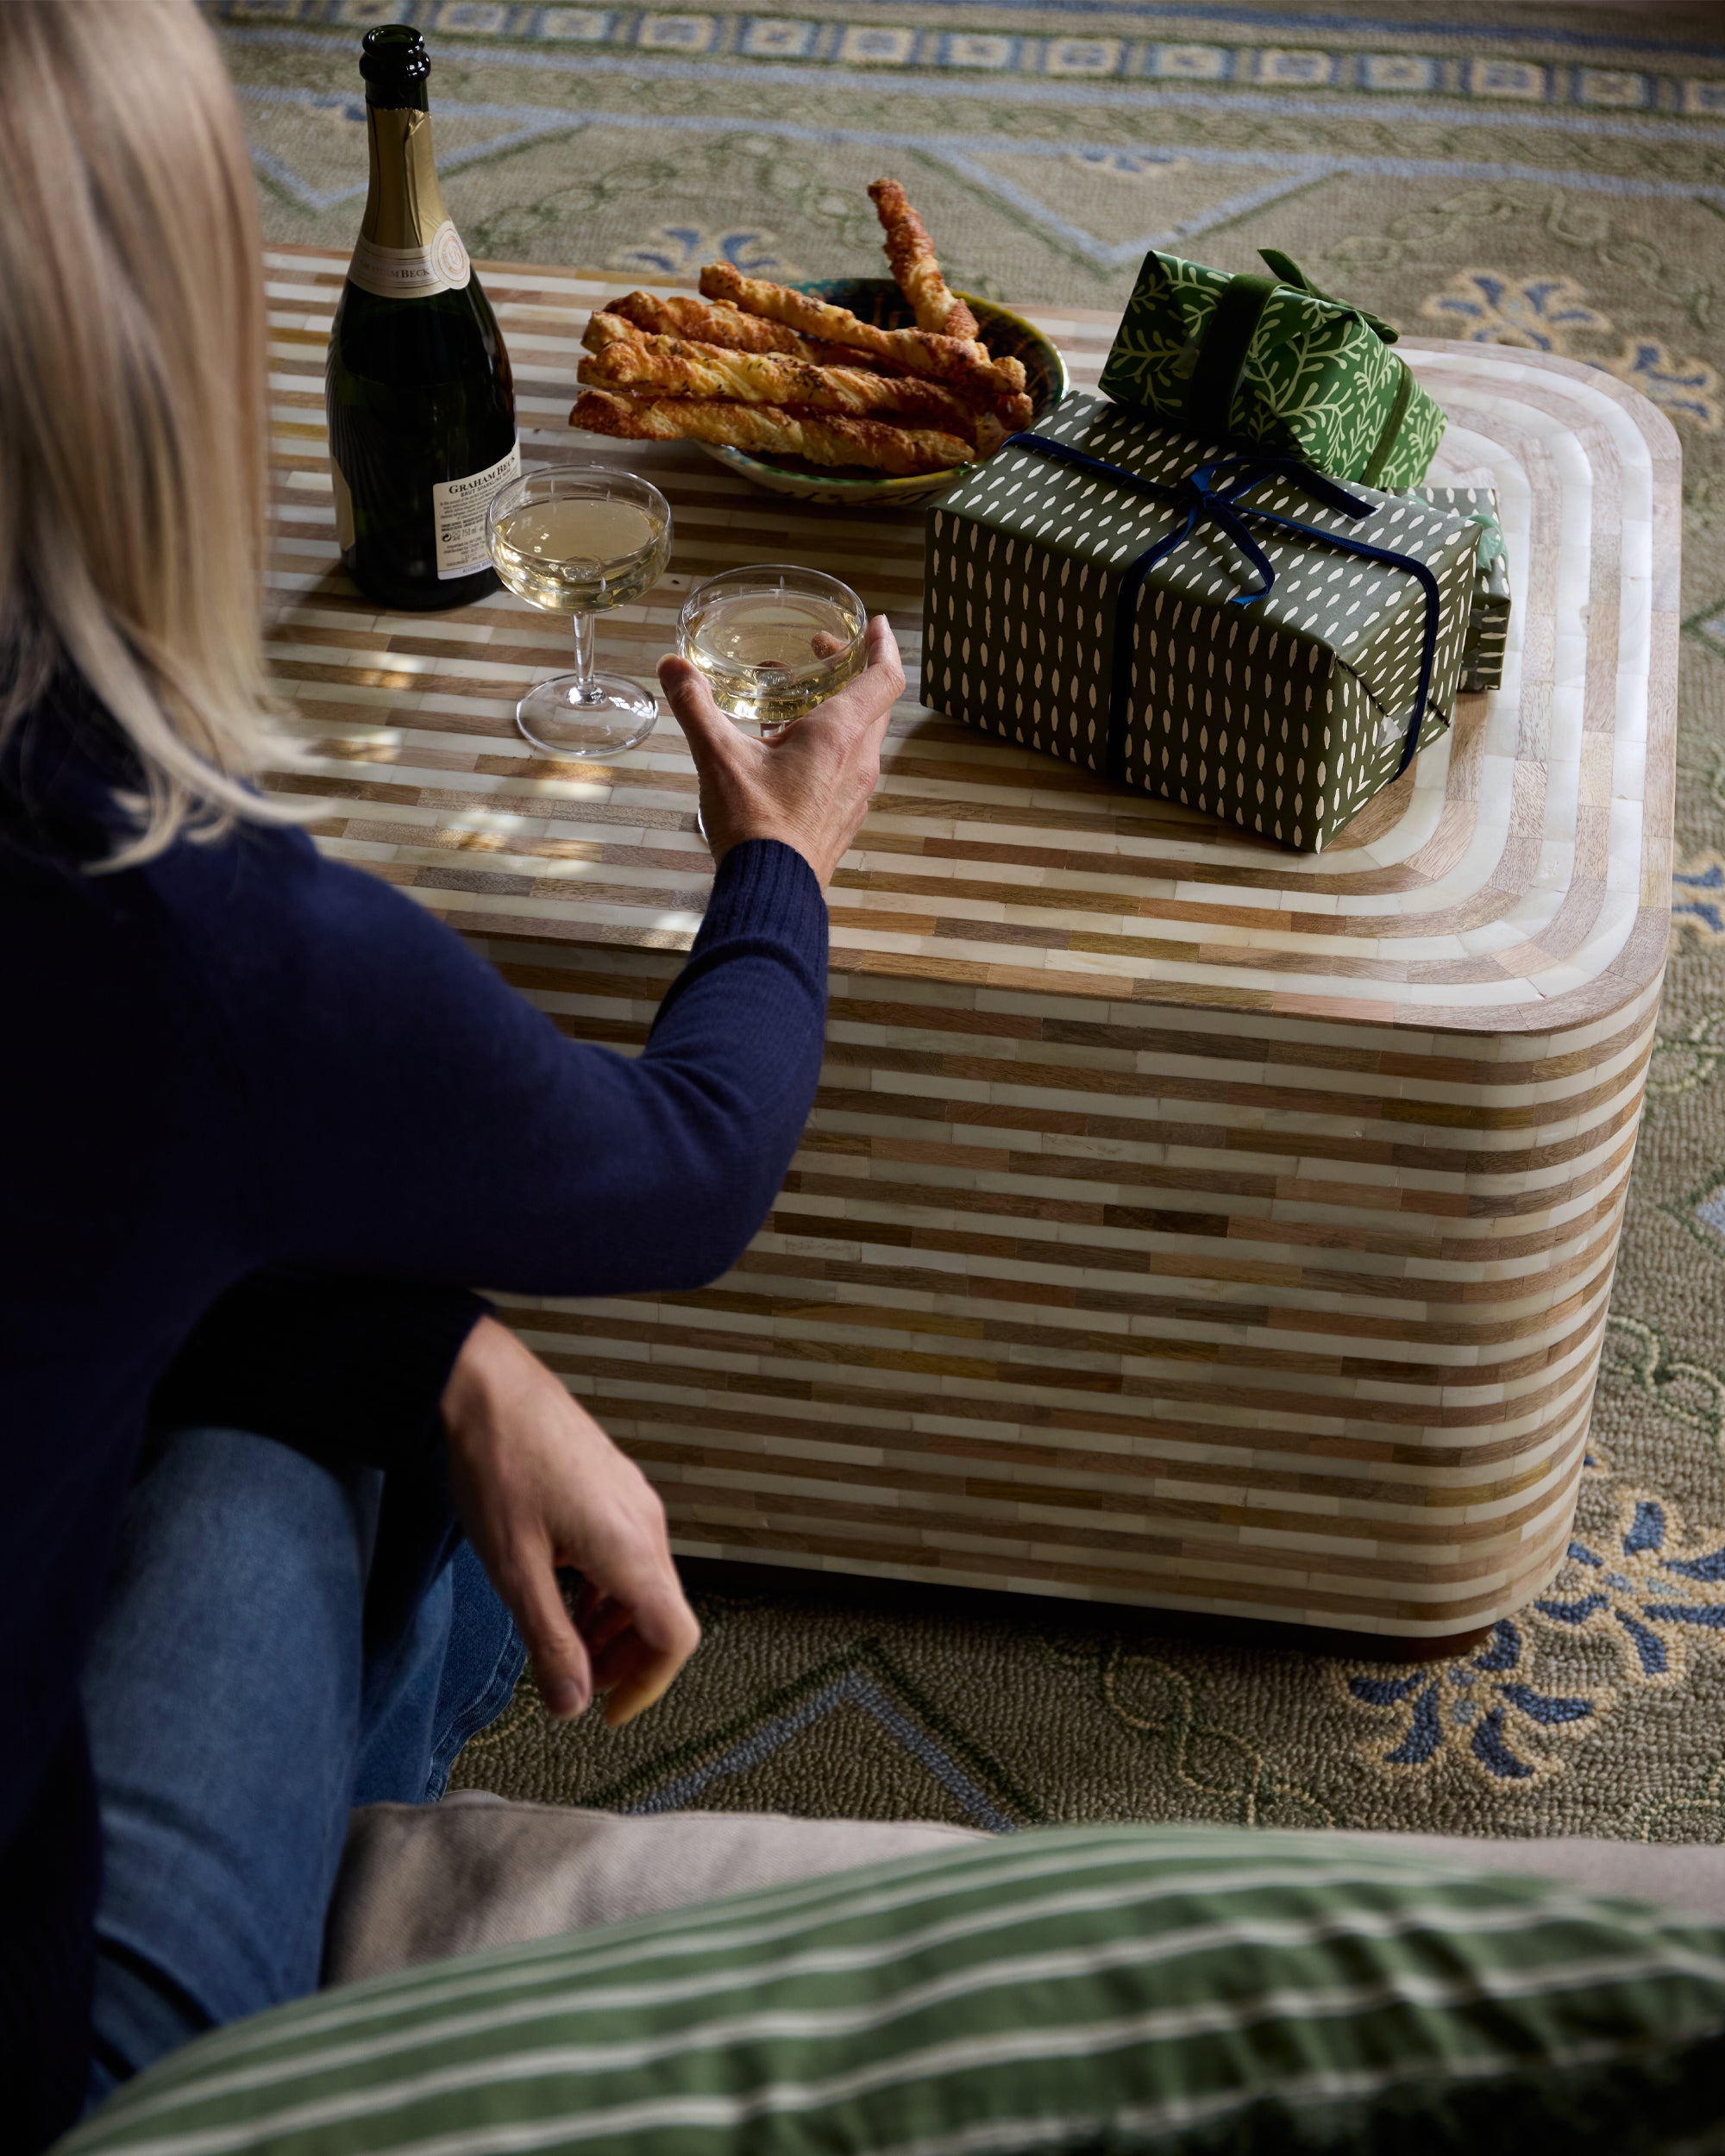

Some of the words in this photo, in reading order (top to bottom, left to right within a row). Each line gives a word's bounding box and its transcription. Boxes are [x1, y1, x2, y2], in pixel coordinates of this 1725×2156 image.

[401, 268, 430, 278] BECK
[448, 471, 496, 494] GRAHAM
[496, 456, 516, 475] BECK
[460, 489, 475, 498] BRUT
[477, 476, 502, 492] SPARKLING
[461, 529, 471, 537] 750
